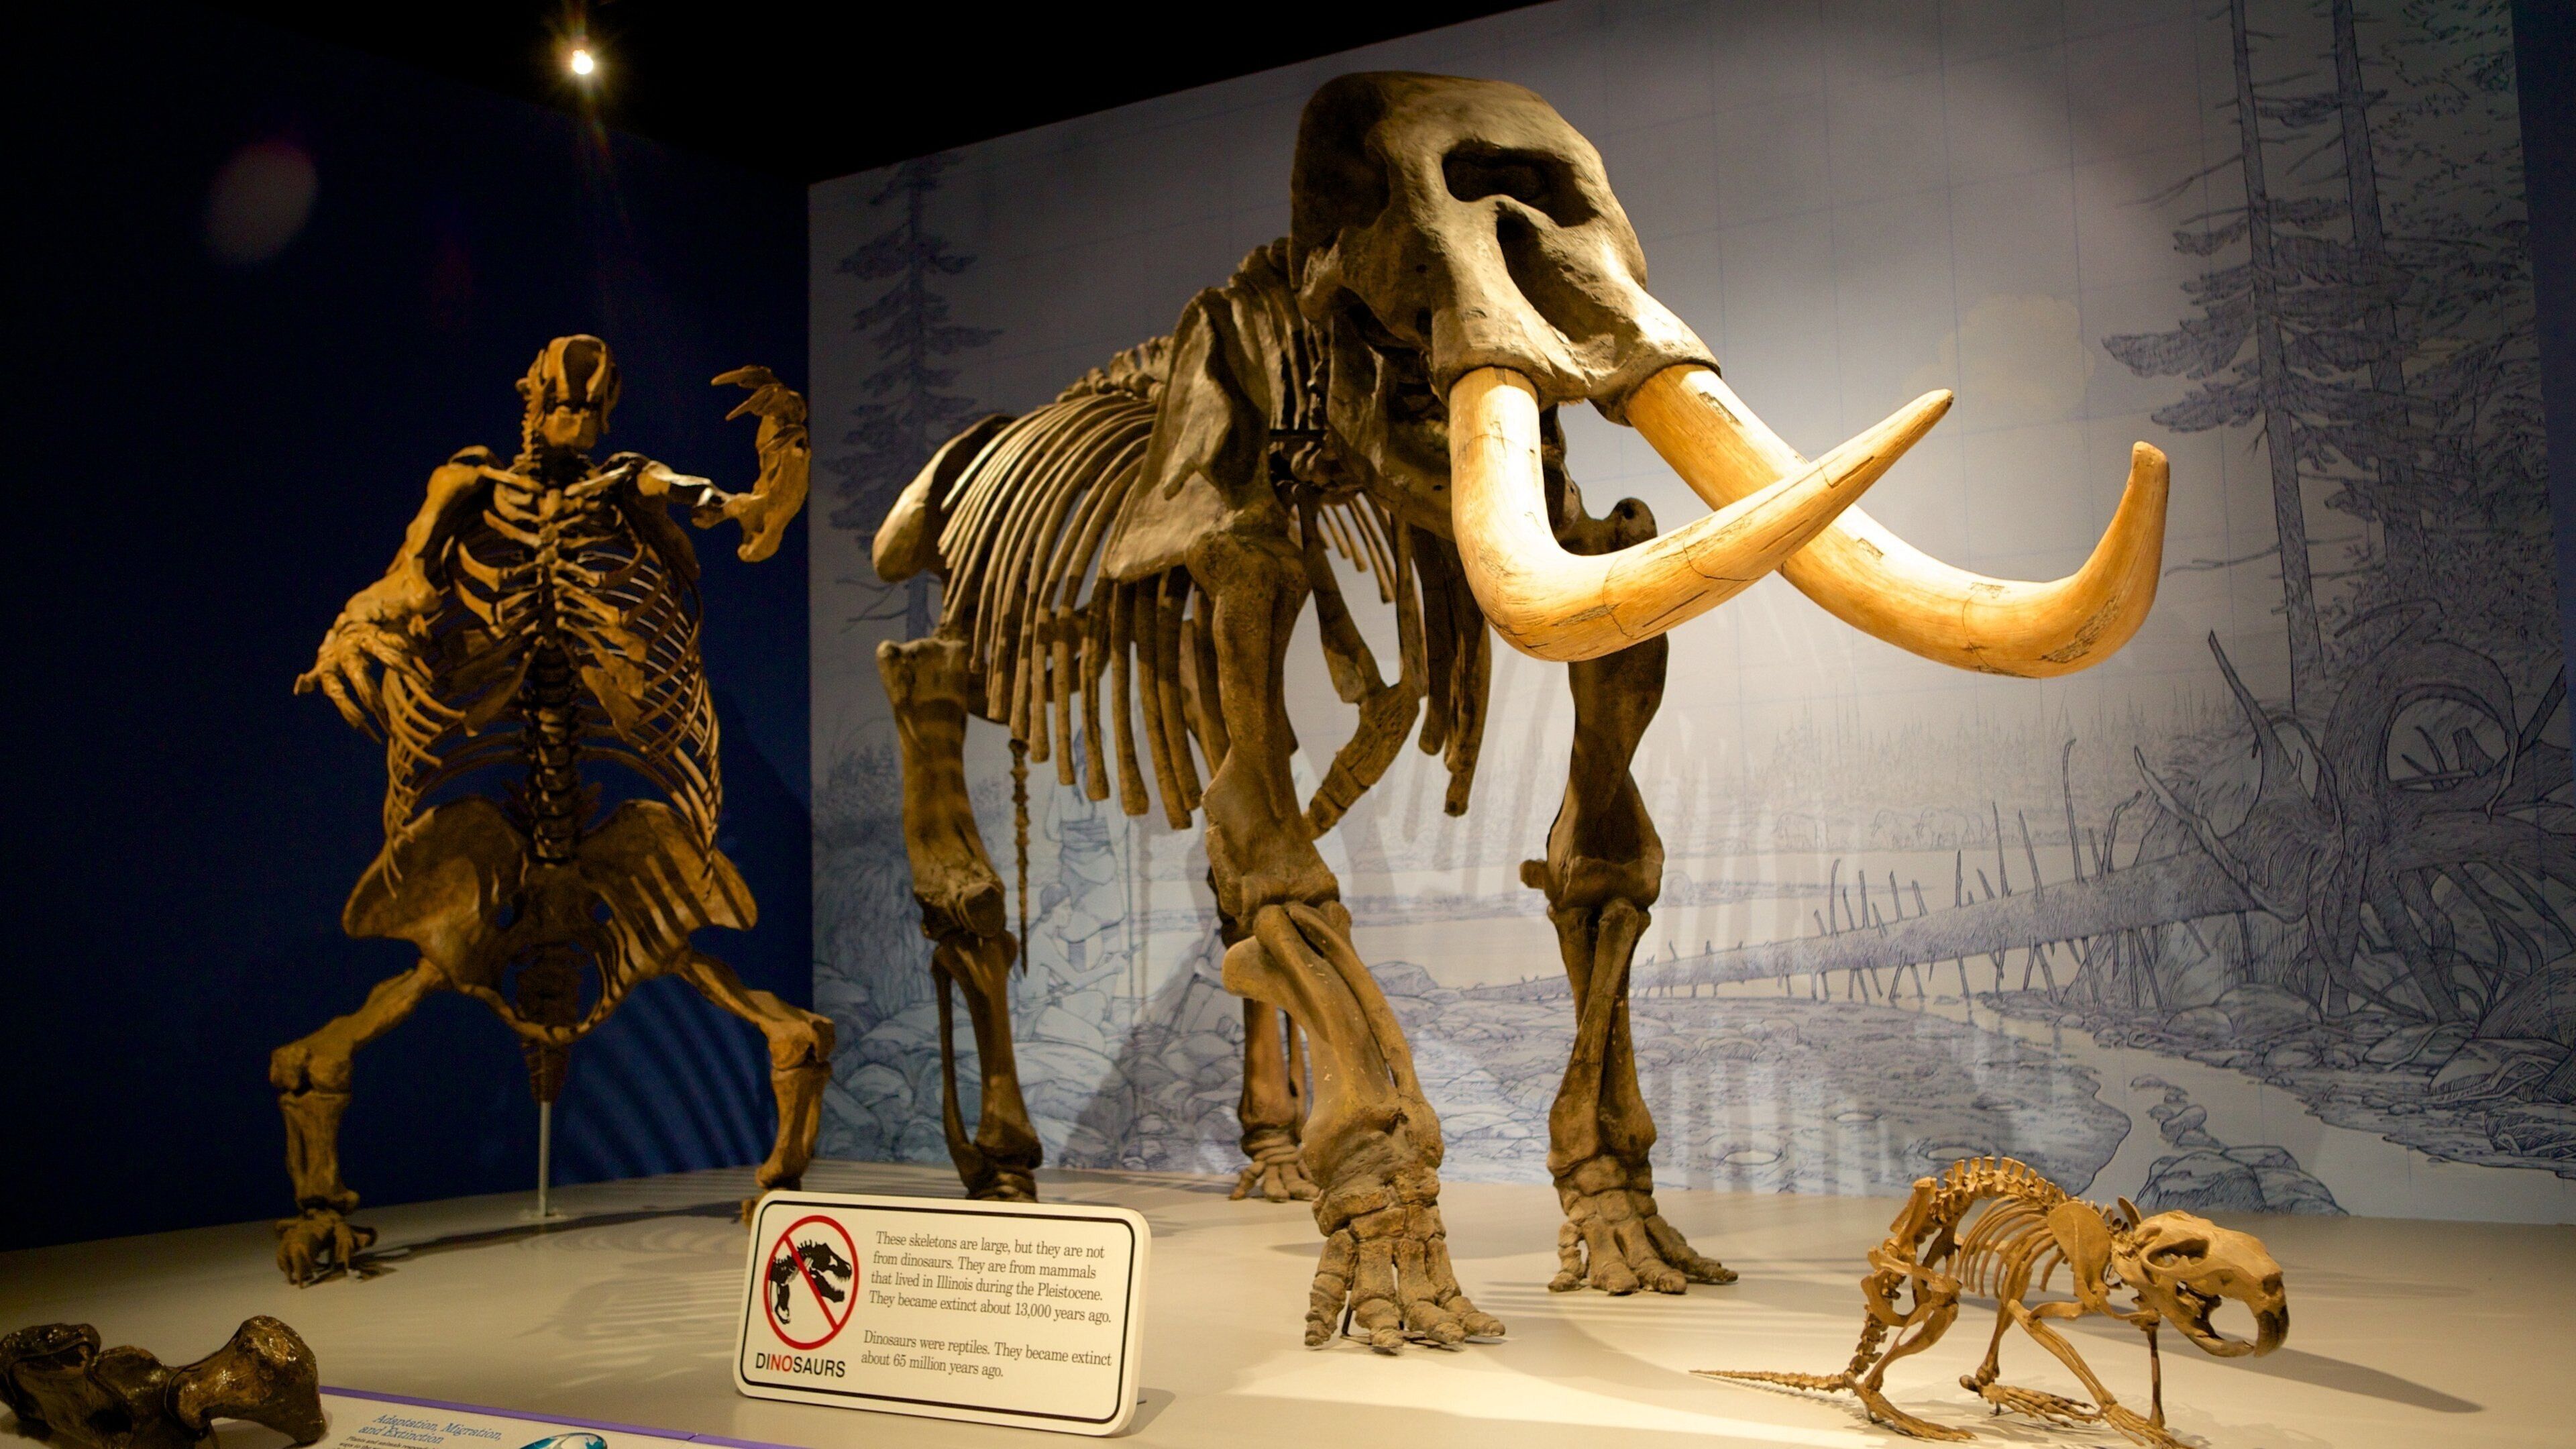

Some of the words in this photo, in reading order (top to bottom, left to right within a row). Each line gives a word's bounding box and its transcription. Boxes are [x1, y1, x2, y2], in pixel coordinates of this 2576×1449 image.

[876, 1231, 906, 1246] These
[909, 1233, 957, 1248] skeletons
[960, 1240, 977, 1250] are
[981, 1237, 1010, 1254] large,
[1014, 1239, 1032, 1254] but
[1036, 1240, 1061, 1258] they
[1064, 1246, 1082, 1257] are
[1086, 1246, 1105, 1258] not
[873, 1250, 897, 1265] from
[901, 1252, 953, 1269] dinosaurs.
[958, 1256, 985, 1274] They
[988, 1262, 1006, 1272] are
[1009, 1260, 1035, 1275] from
[1040, 1265, 1096, 1279] mammals
[871, 1271, 892, 1285] that
[895, 1272, 920, 1287] lived
[923, 1275, 933, 1287] in
[936, 1275, 973, 1291] Illinois
[976, 1278, 1014, 1297] during
[1016, 1281, 1034, 1295] the
[1037, 1282, 1102, 1301] Pleistocene.
[869, 1290, 895, 1307] They
[898, 1292, 937, 1308] became
[941, 1297, 977, 1311] extinct
[980, 1299, 1011, 1315] about
[1015, 1302, 1051, 1318] 13,000
[1053, 1309, 1085, 1322] years
[1088, 1311, 1111, 1326] ago.
[863, 1330, 916, 1348] Dinosaurs
[920, 1339, 945, 1350] were
[947, 1340, 989, 1355] reptiles.
[995, 1342, 1022, 1360] They
[1026, 1344, 1068, 1362] became
[1072, 1350, 1112, 1366] extinct
[755, 1352, 845, 1378] DINOSAURS
[861, 1350, 890, 1366] about
[894, 1354, 906, 1367] 65
[910, 1356, 946, 1371] million
[948, 1362, 979, 1375] years
[981, 1366, 1003, 1379] ago.
[358, 1426, 386, 1435] and
[382, 1426, 443, 1444] Extinction
[372, 1414, 438, 1431] Adaptation,
[440, 1423, 502, 1441] Migration,
